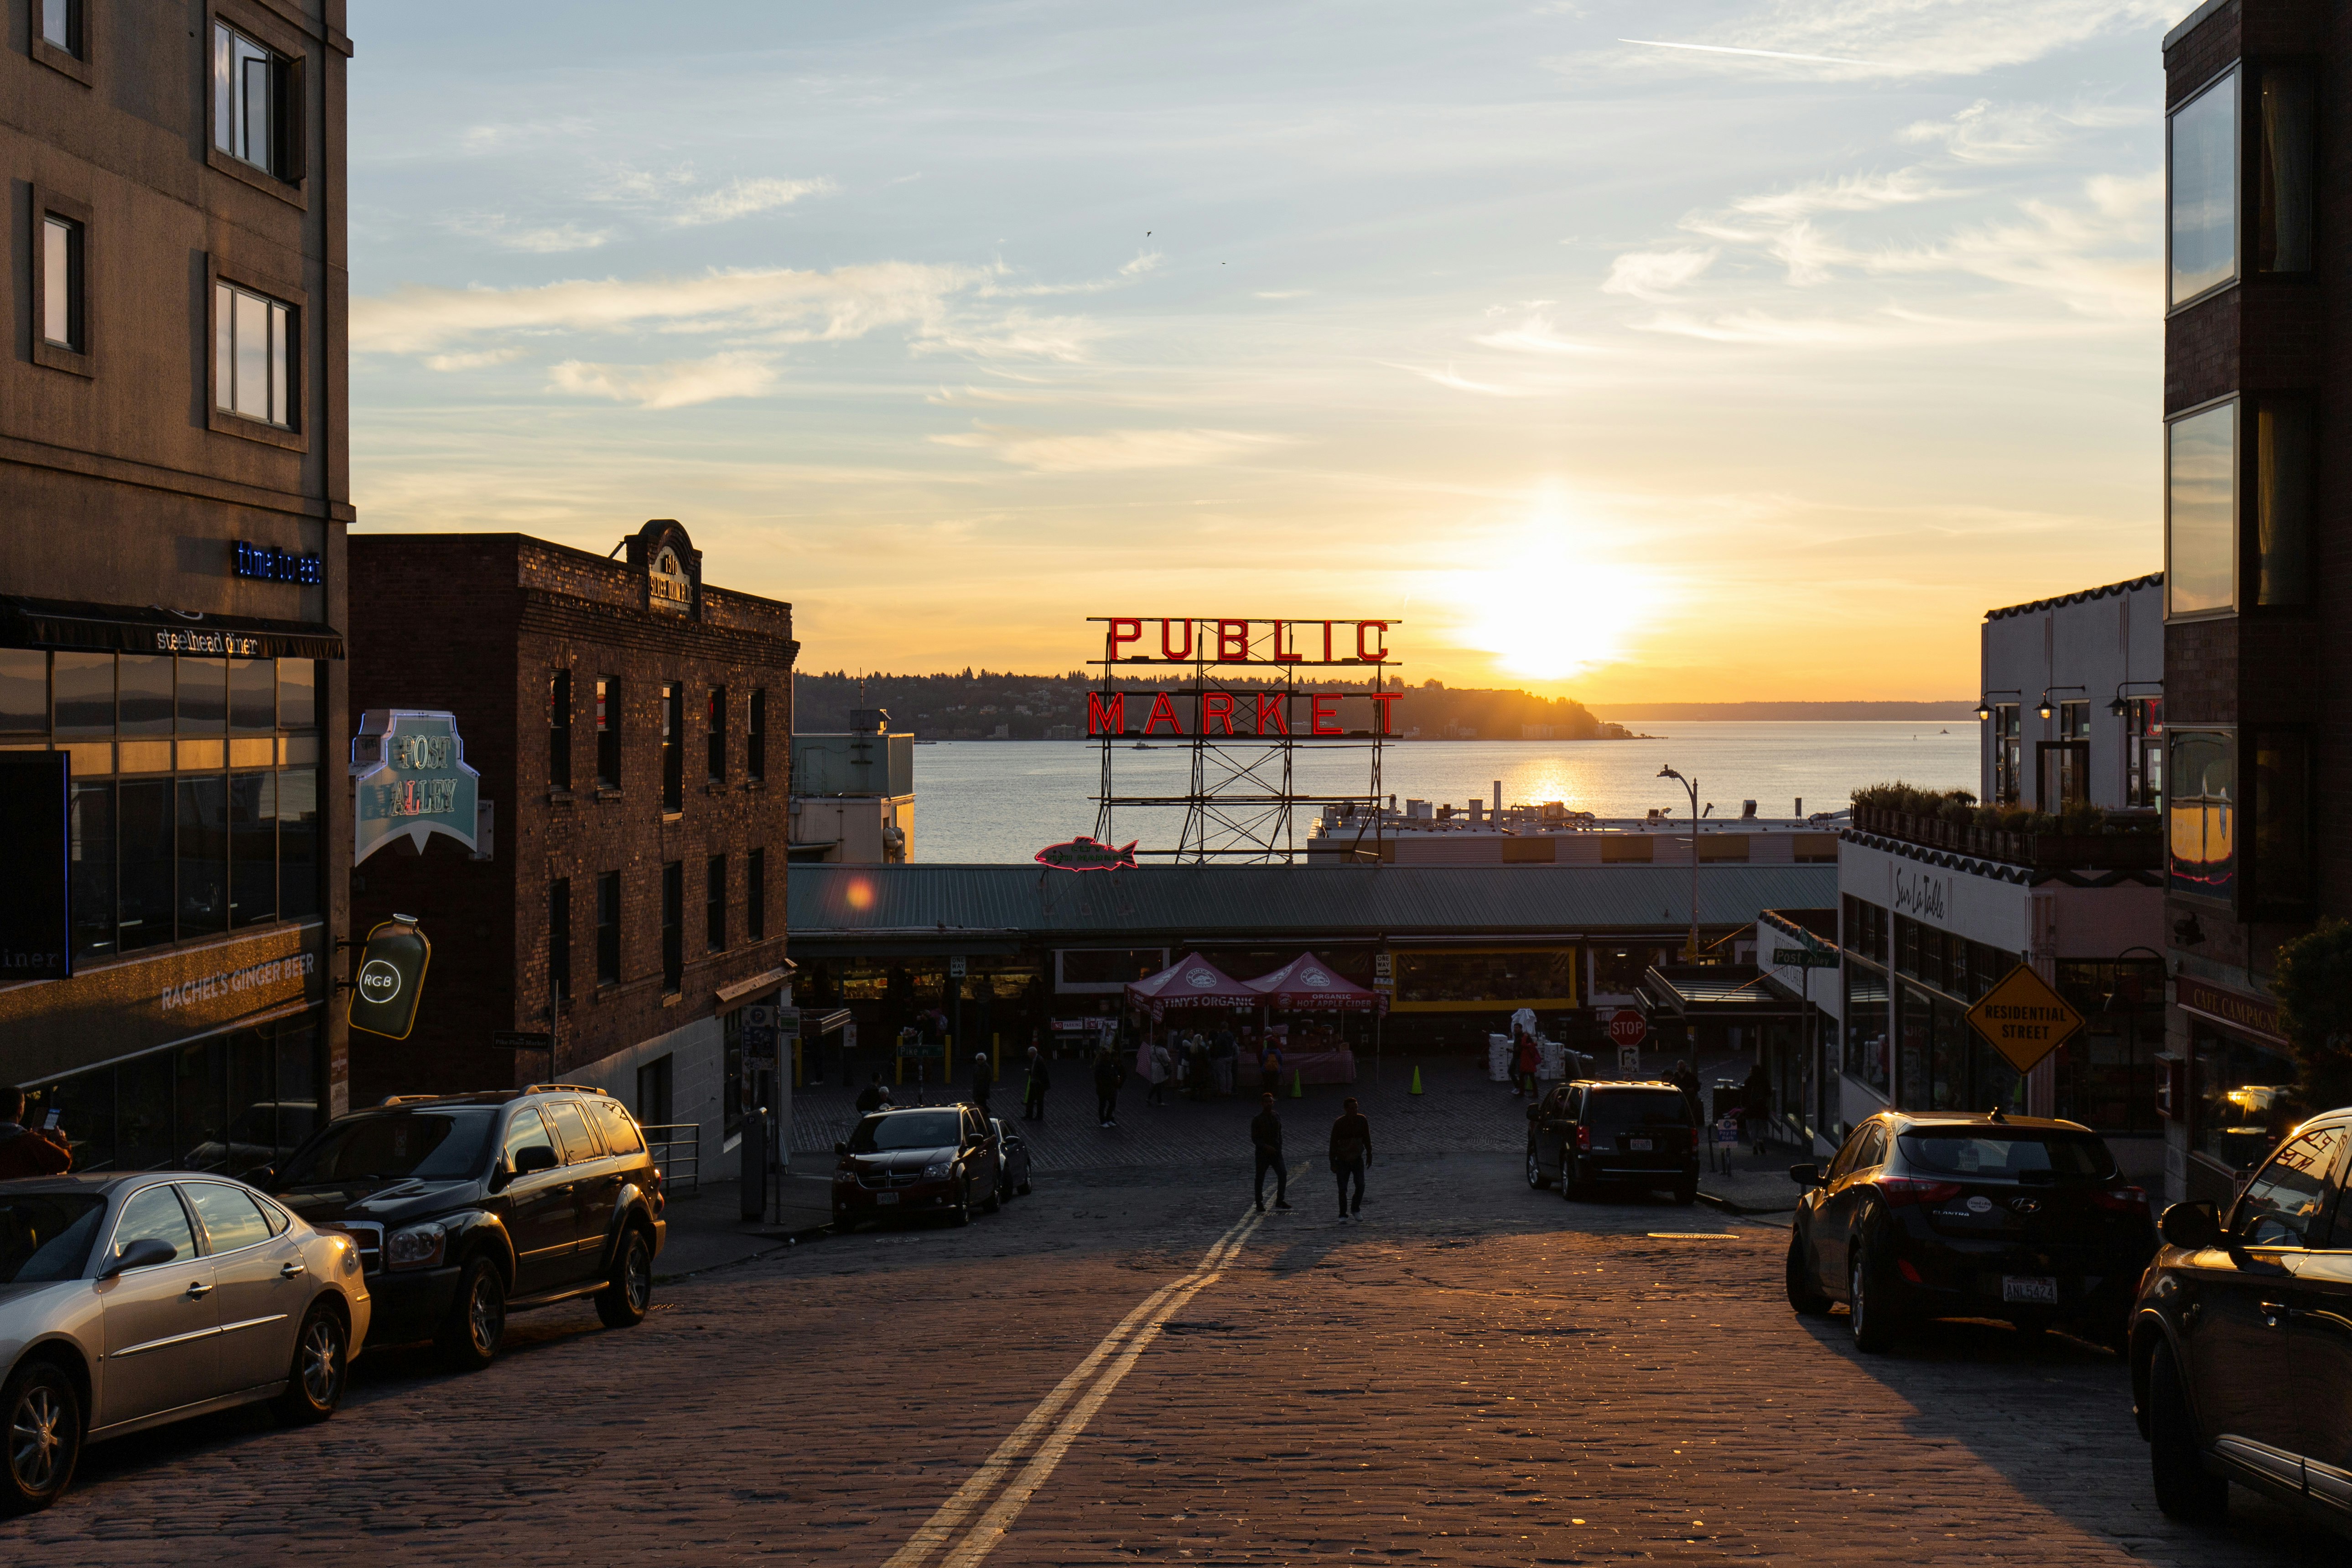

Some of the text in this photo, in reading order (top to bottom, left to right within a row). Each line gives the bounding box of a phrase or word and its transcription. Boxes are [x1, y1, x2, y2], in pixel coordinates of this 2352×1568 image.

[238, 540, 321, 585] time to eat
[665, 555, 678, 575] 1910
[157, 628, 258, 655] steelhead diner
[1110, 618, 1389, 661] PUBLIC
[1088, 691, 1404, 735] MARKET
[401, 735, 451, 769] POST
[391, 779, 457, 816] ALLEY
[1895, 867, 1944, 919] Sur La Table
[1776, 950, 1802, 963] Post
[1807, 956, 1829, 966] Alley
[162, 953, 314, 1011] RACHEL'S GINGER BEER
[364, 974, 392, 987] RGB
[1164, 996, 1256, 1007] TINY'S ORGANIC
[1985, 1005, 2066, 1022] RESIDENTIAL
[1612, 1022, 1643, 1035] STOP
[2002, 1024, 2049, 1039] STREET
[900, 1047, 918, 1055] Pike
